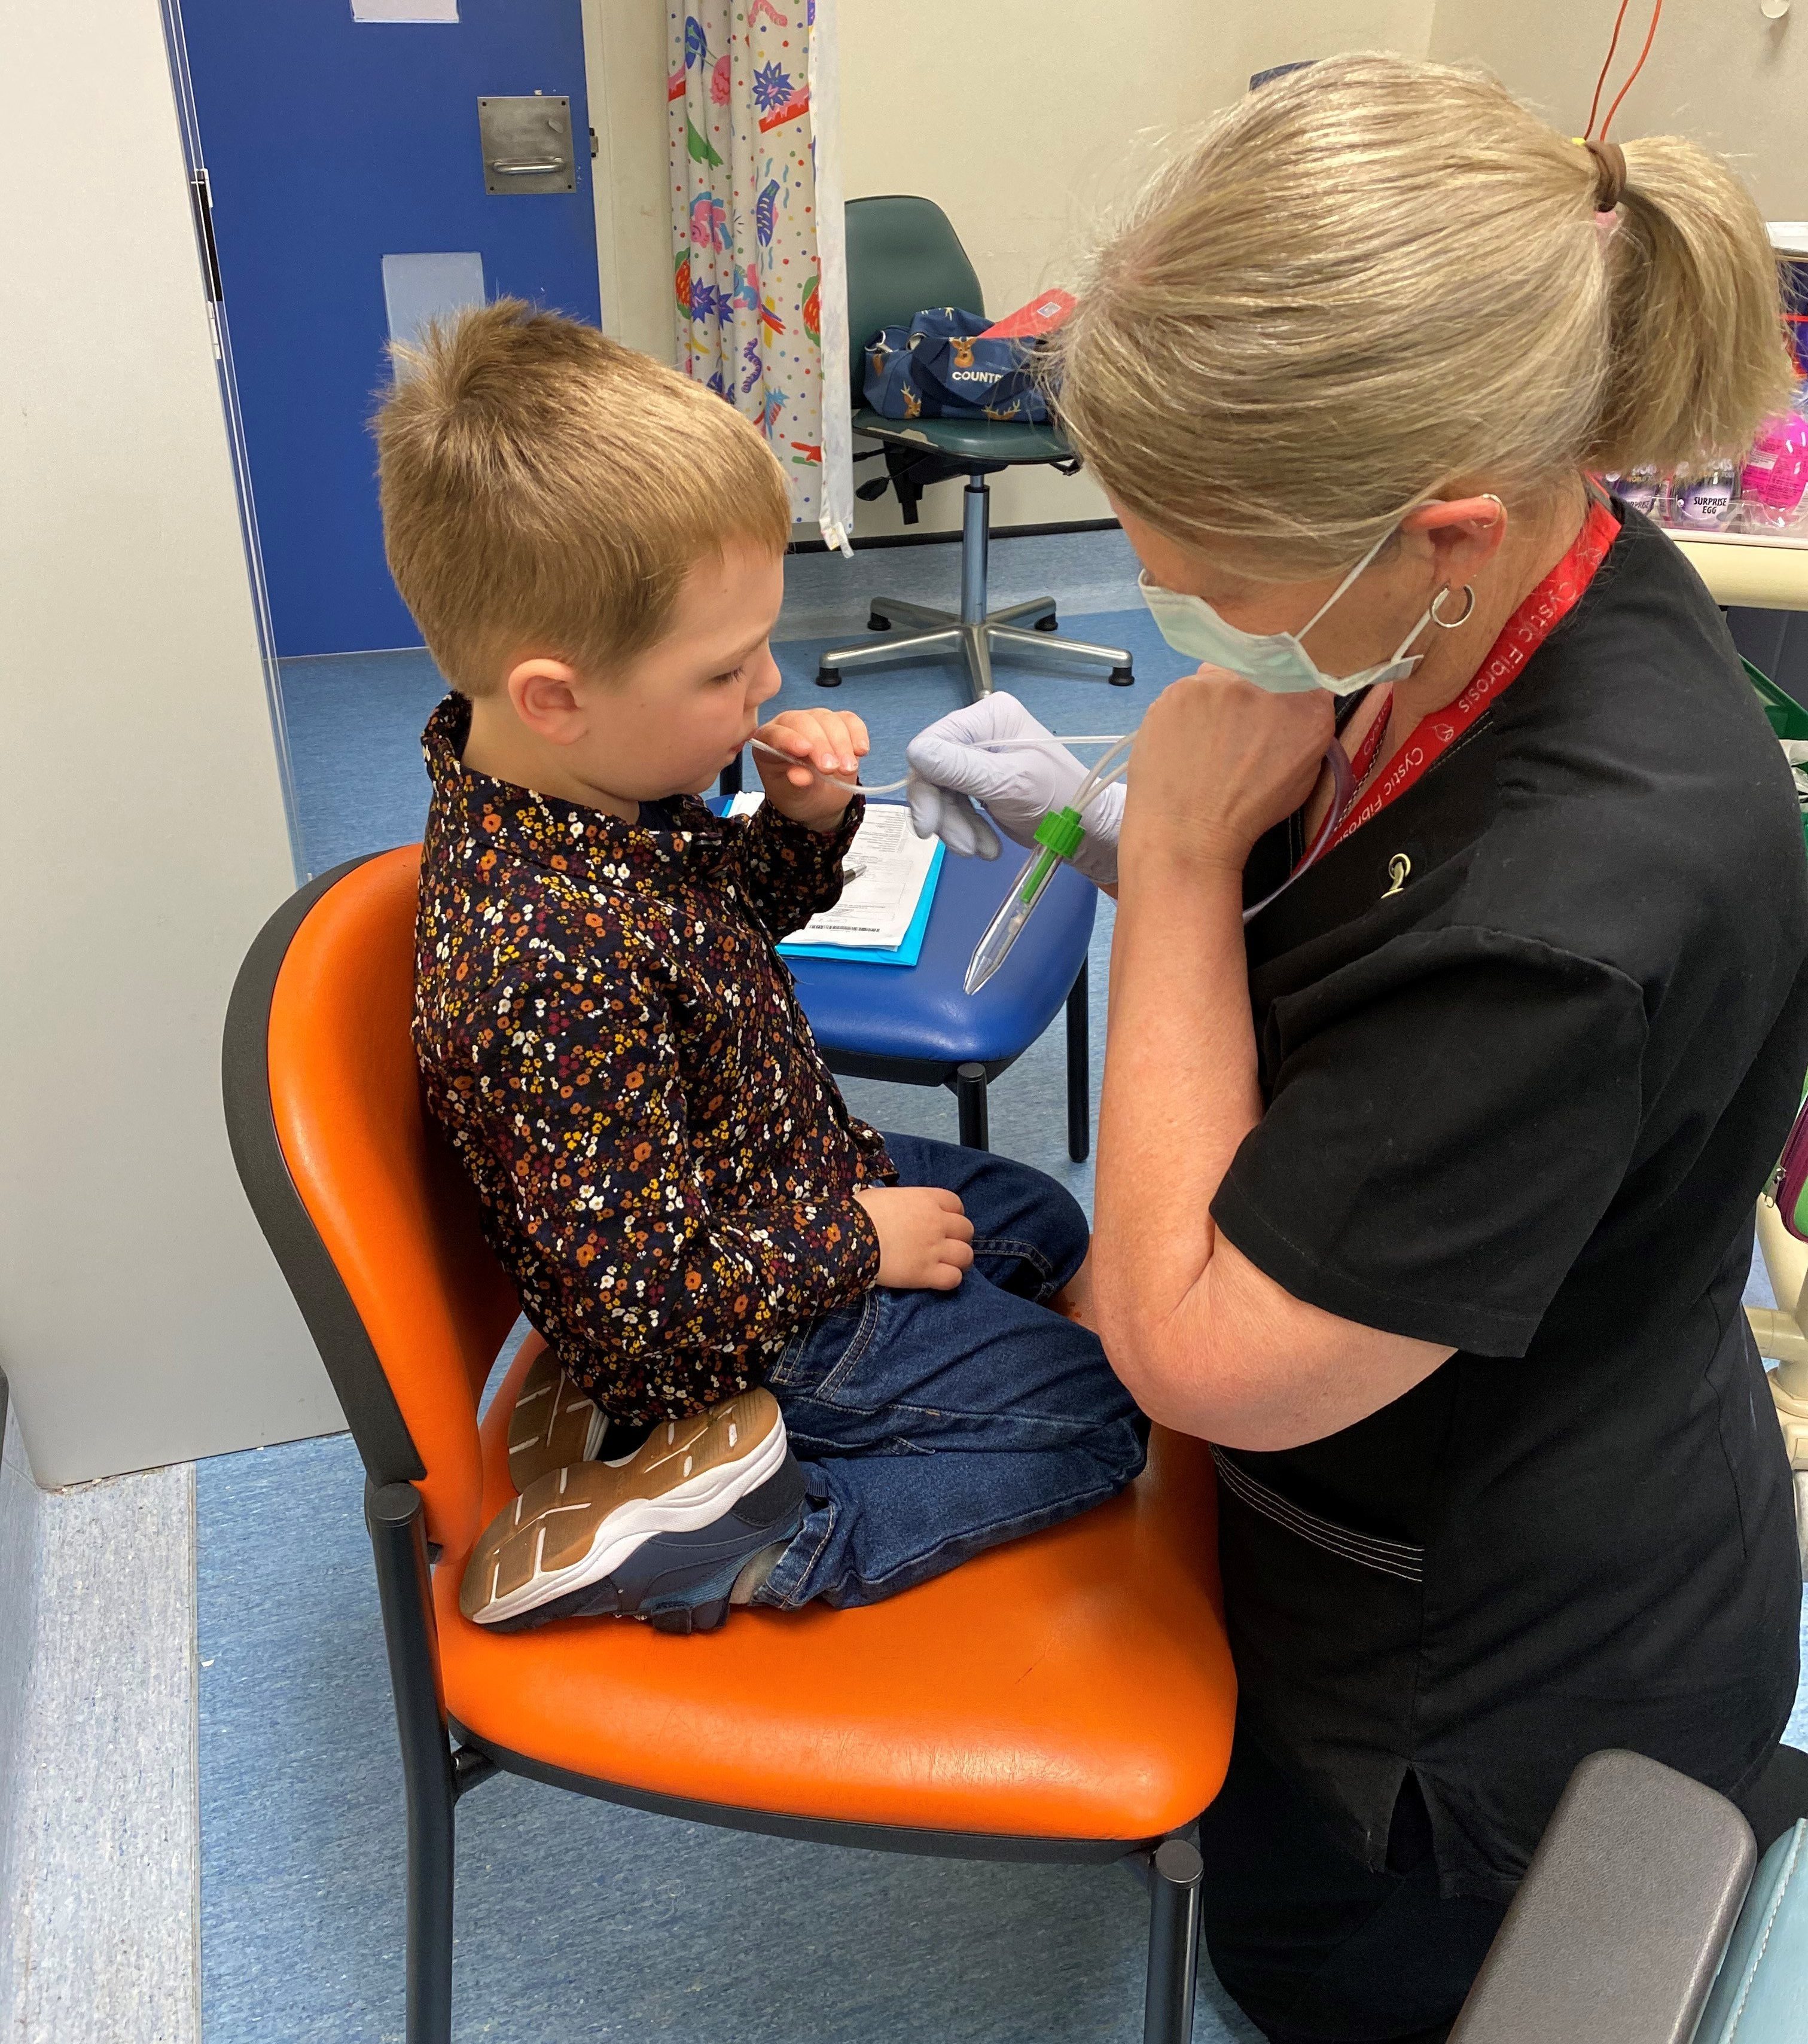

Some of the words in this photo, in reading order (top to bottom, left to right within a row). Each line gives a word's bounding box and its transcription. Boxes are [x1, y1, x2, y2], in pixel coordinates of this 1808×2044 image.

[952, 371, 1004, 383] COUNTR
[1694, 496, 1727, 507] SURPRISE
[1519, 582, 1577, 642] Cystic
[1458, 644, 1523, 712] Fibrosis
[1384, 747, 1424, 796] Cystic
